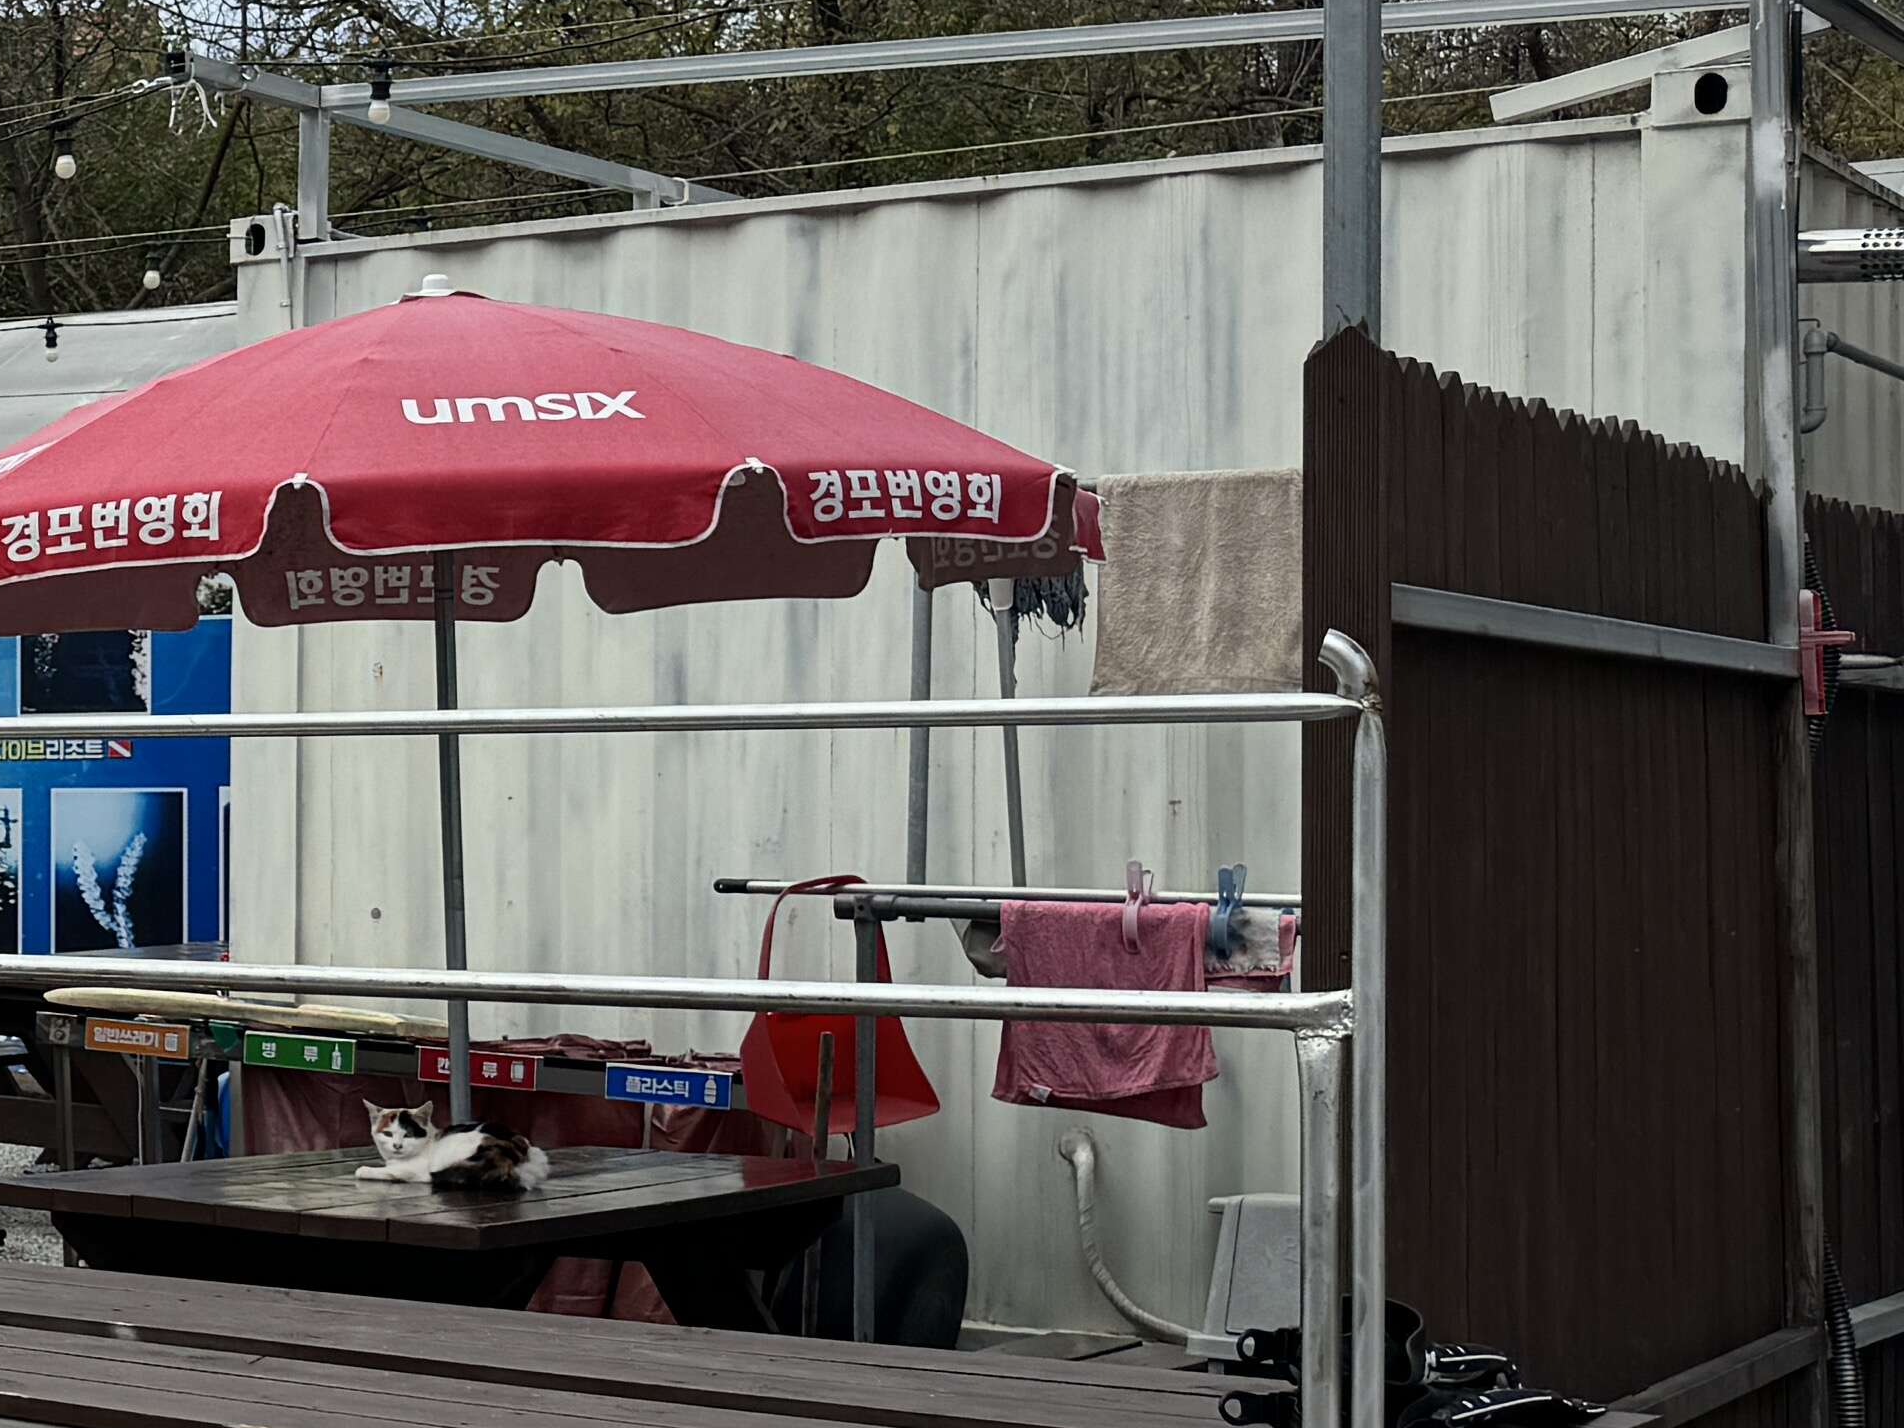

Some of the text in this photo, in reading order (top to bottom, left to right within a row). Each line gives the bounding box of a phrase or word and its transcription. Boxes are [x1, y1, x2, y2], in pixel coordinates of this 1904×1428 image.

[808, 469, 1002, 524] 경포번영회
[0, 490, 223, 562] 경포번영회
[625, 1074, 690, 1099] 플라스틱
